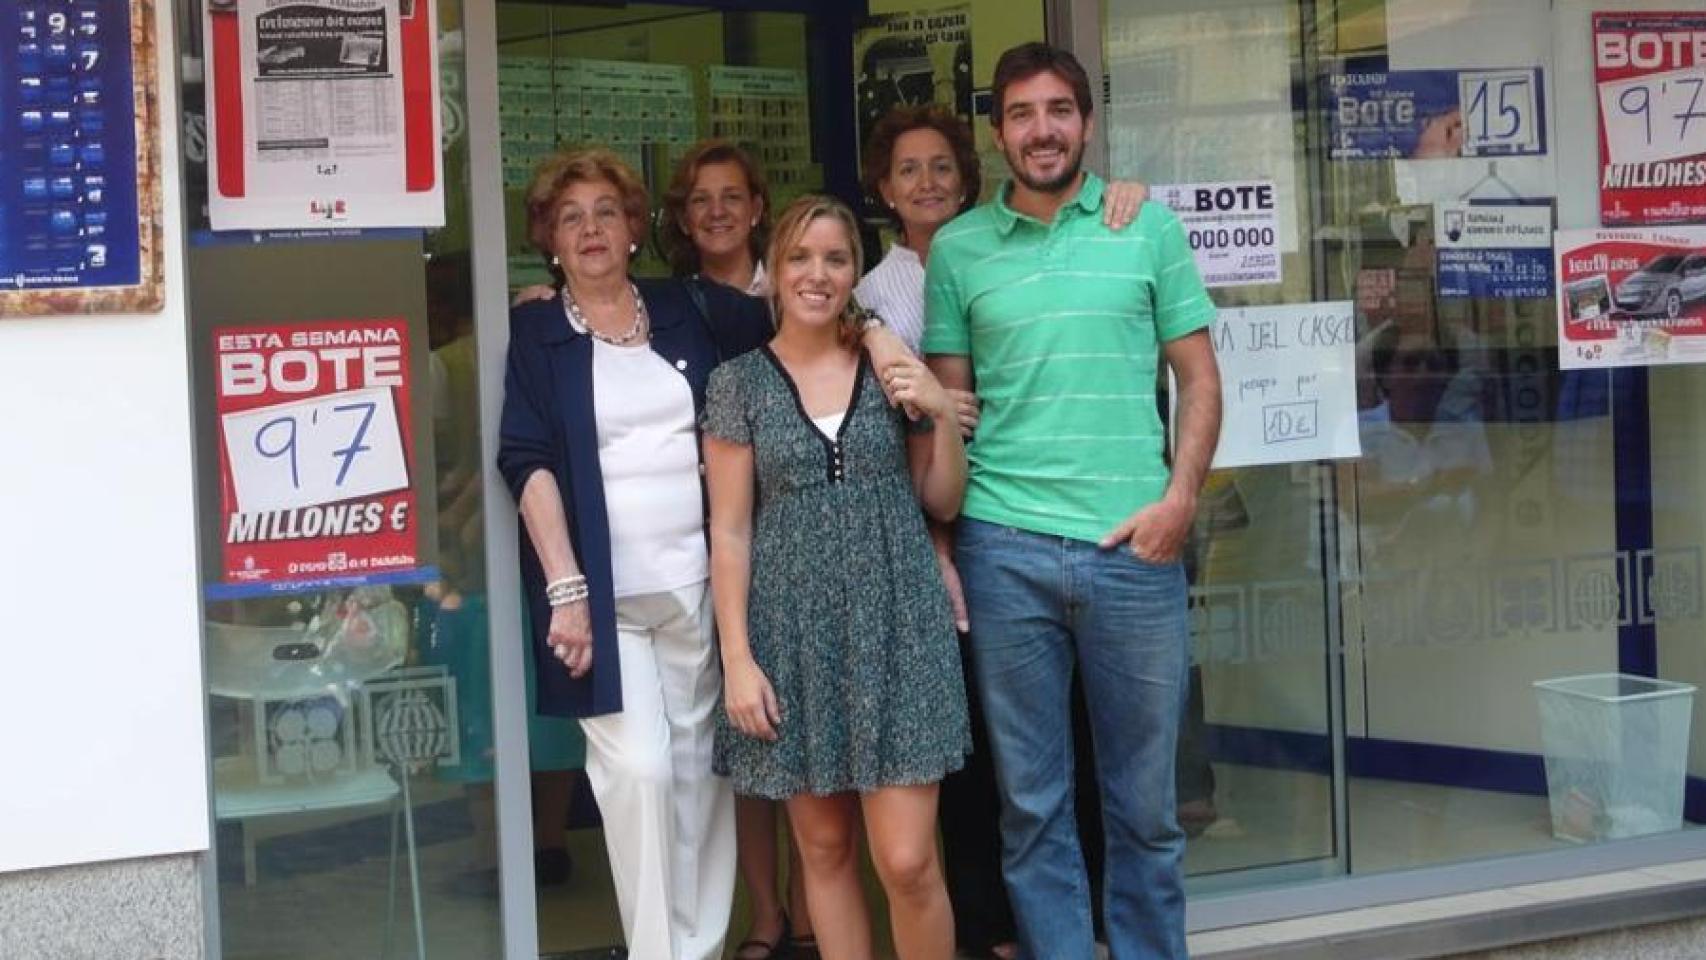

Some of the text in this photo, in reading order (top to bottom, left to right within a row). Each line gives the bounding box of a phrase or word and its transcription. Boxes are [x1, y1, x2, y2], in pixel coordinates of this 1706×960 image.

[1469, 79, 1529, 141] 15
[1195, 185, 1274, 212] BOTE
[1233, 226, 1274, 248] 000
[218, 327, 401, 351] ESTA SEMANA
[220, 344, 404, 397] BOTE
[254, 401, 377, 489] 9'7
[227, 501, 410, 544] MILLONES €
